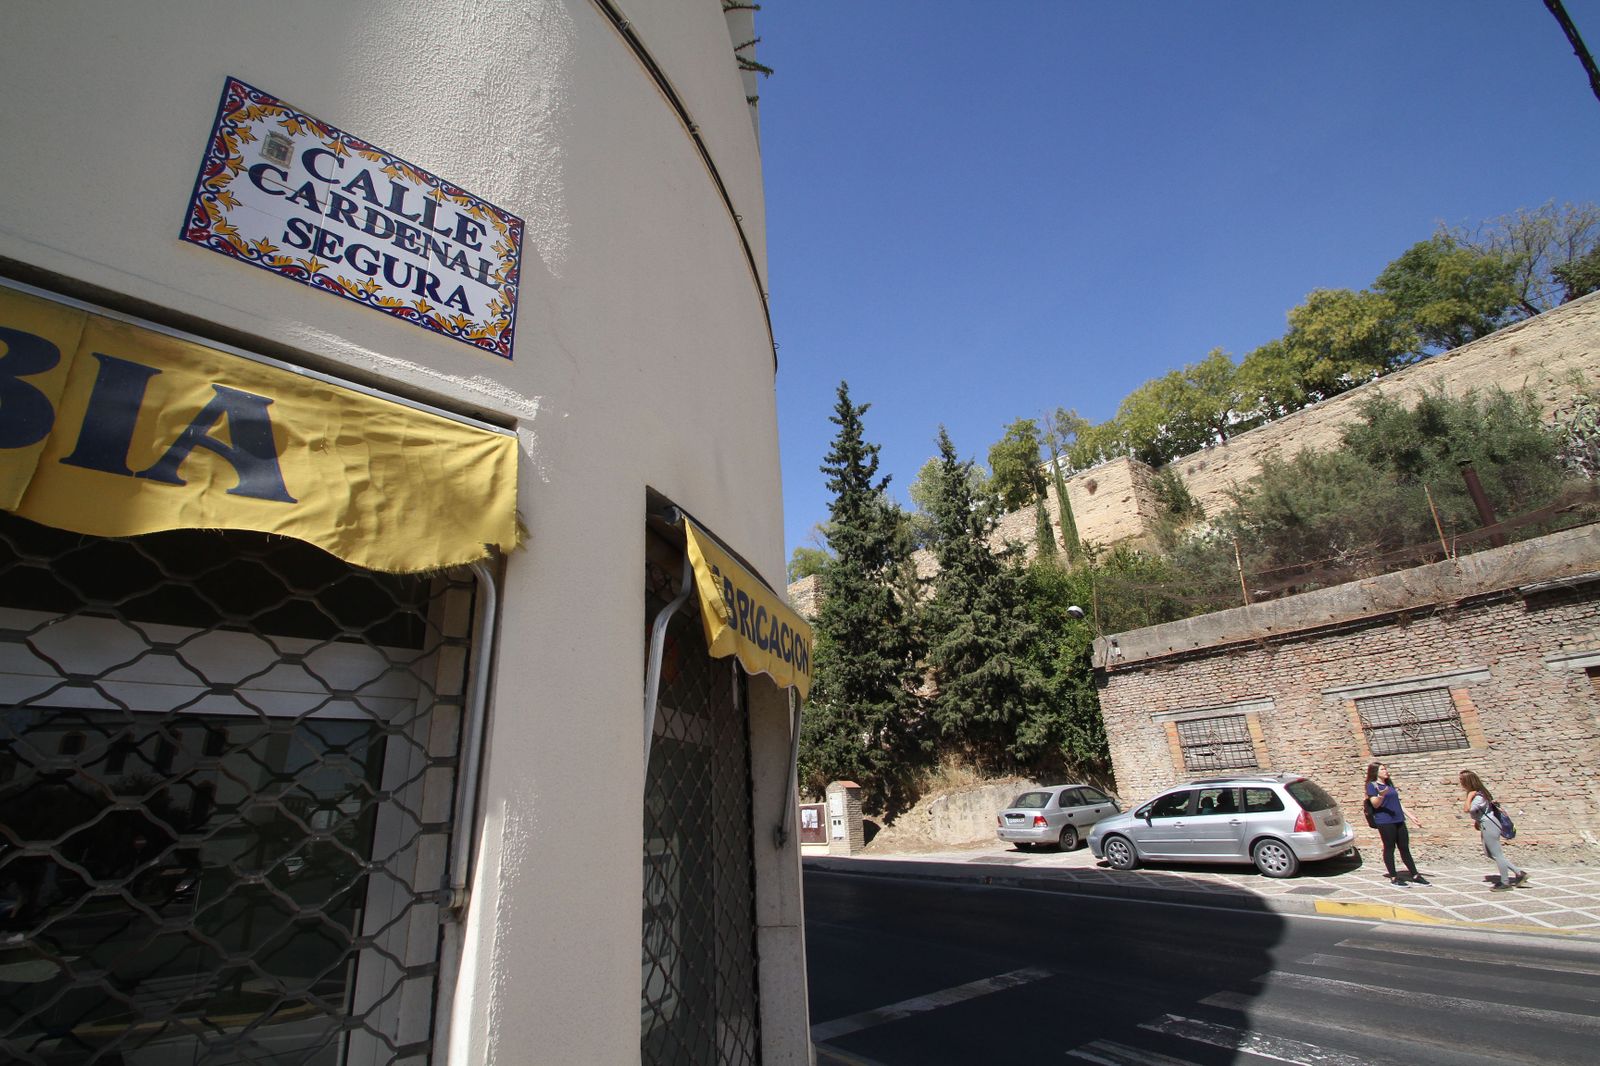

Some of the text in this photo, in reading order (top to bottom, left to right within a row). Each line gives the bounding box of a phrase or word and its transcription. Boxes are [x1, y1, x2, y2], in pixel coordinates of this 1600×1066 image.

[247, 163, 501, 290] CARDENAL
[301, 147, 488, 252] CALLE
[281, 217, 474, 317] SEGURA
[711, 564, 809, 677] BRICACION
